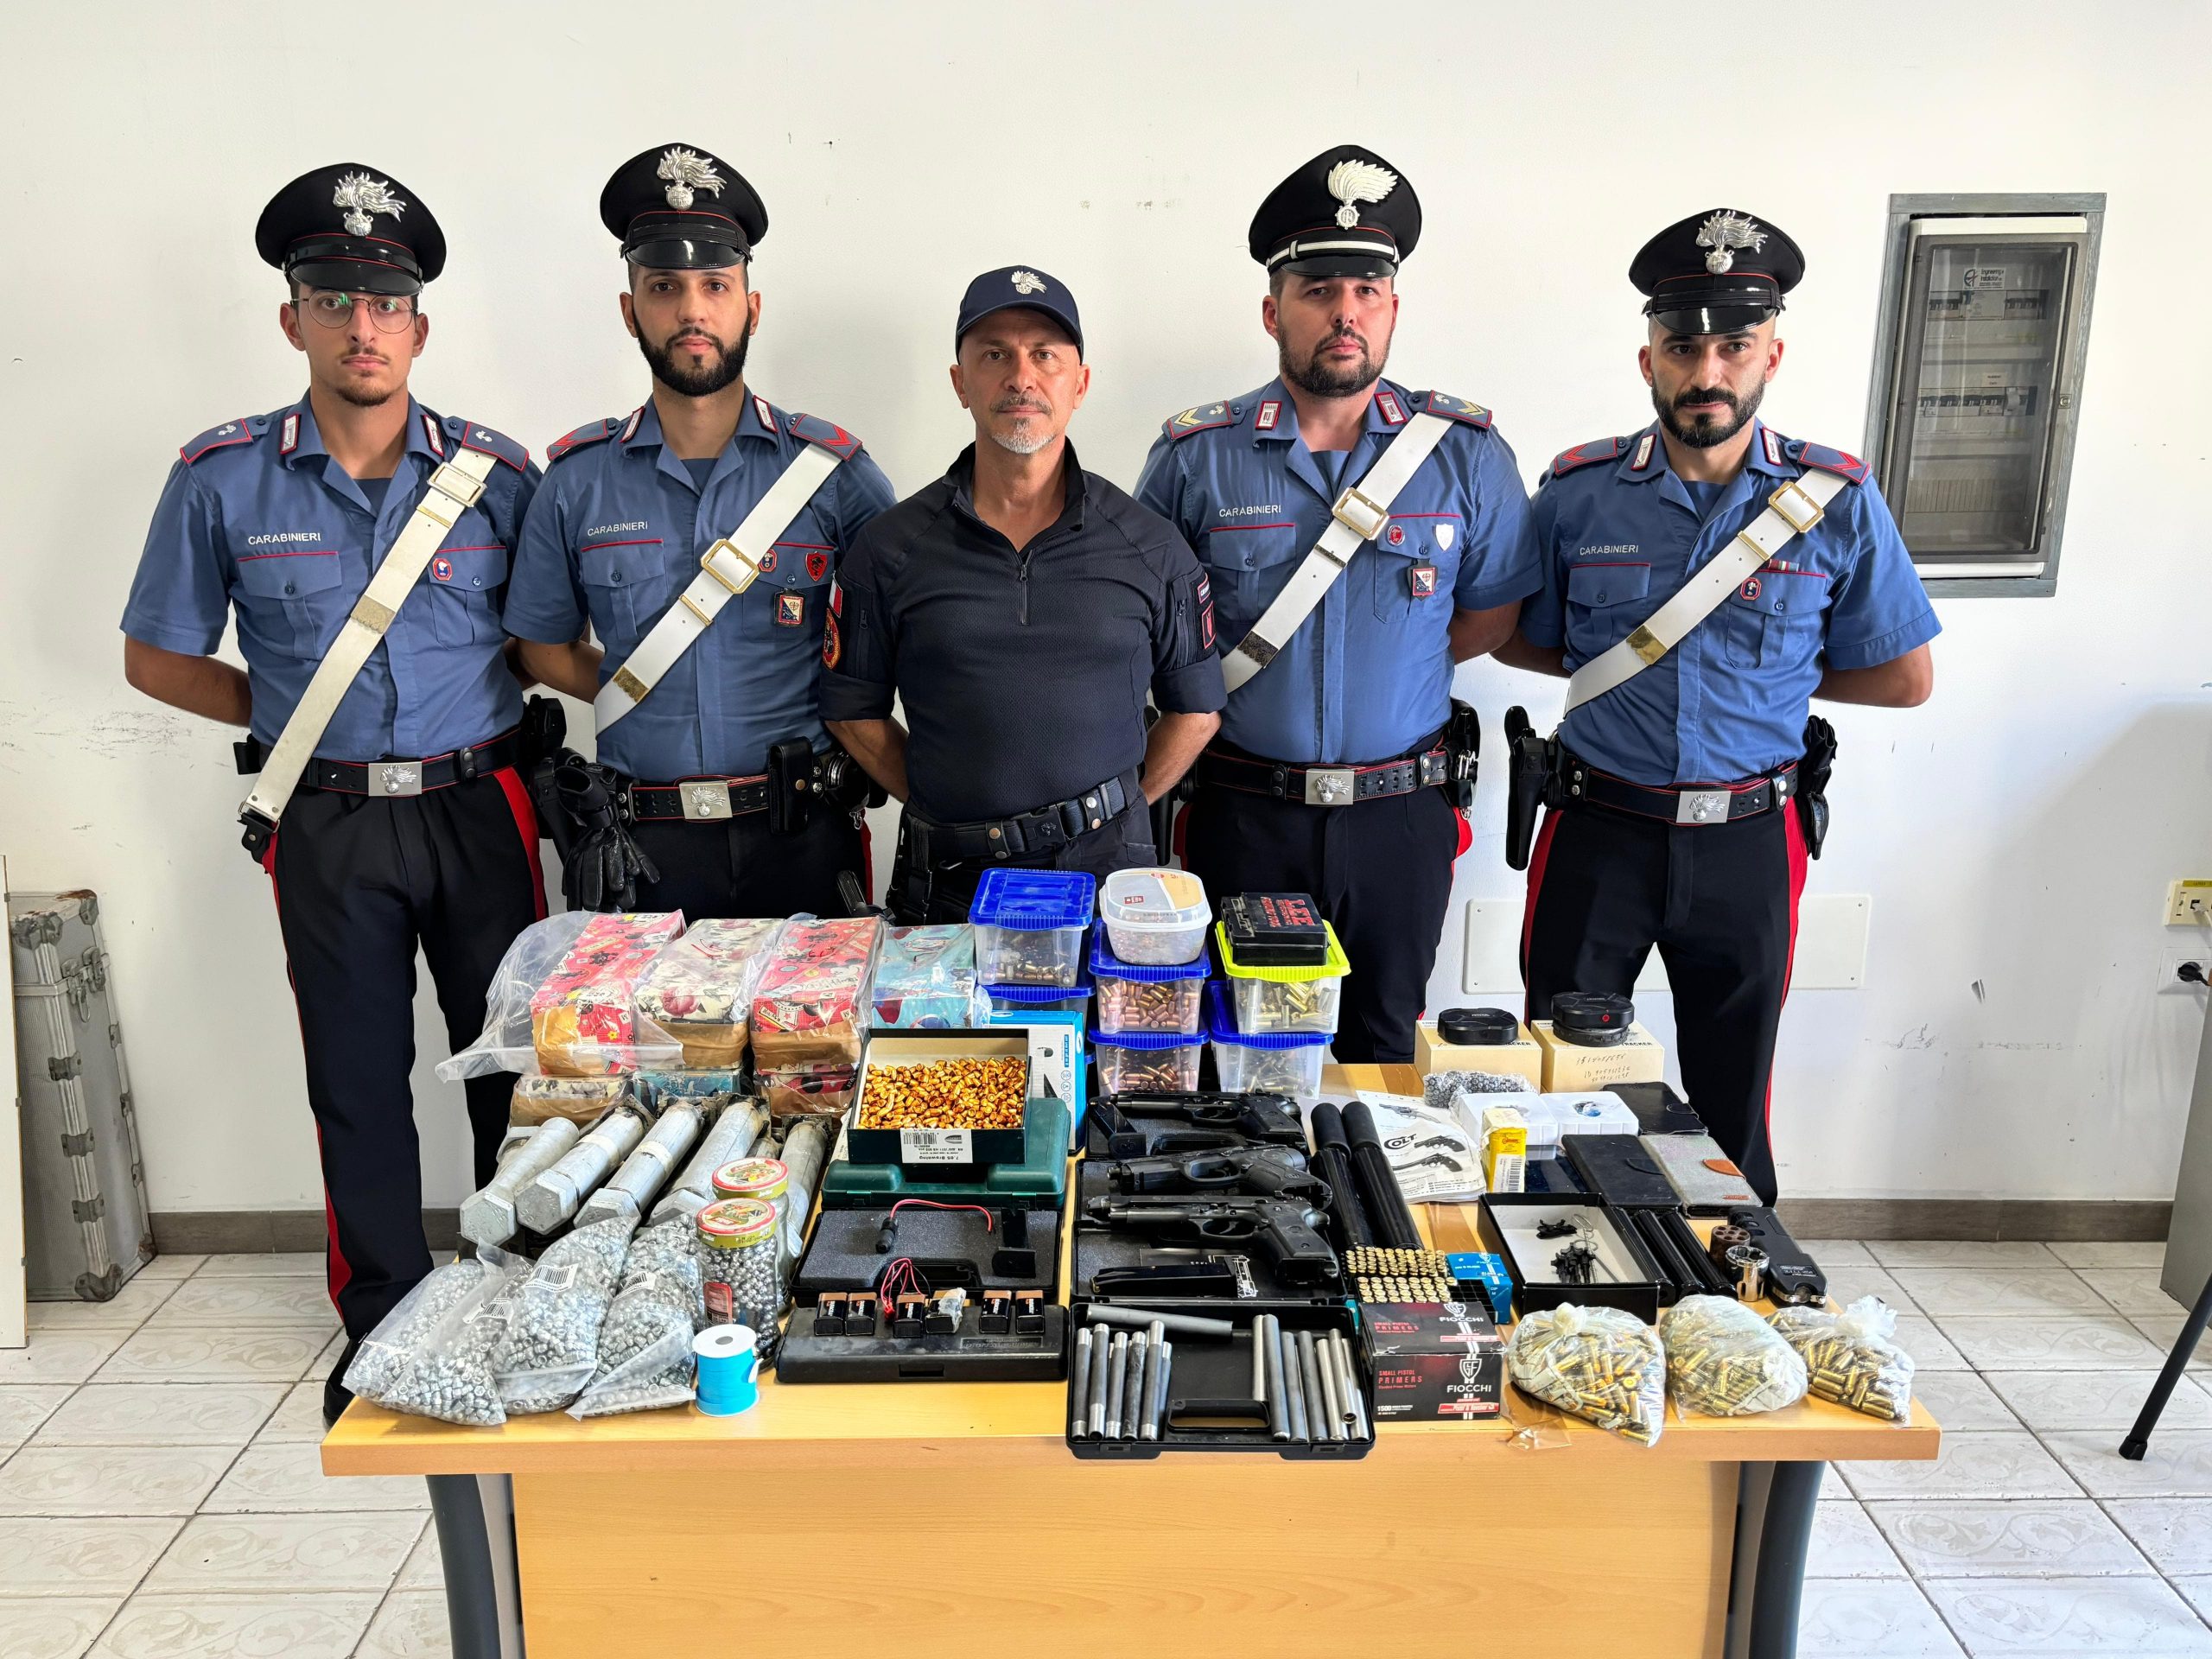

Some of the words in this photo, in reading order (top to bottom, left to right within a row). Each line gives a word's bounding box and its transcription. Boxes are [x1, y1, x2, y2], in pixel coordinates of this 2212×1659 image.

[1219, 505, 1281, 518] CARABINIERI
[588, 521, 648, 537] CARABINIERI
[248, 532, 321, 545] CARABINIERI
[1580, 544, 1639, 556] CARABINIERI
[1284, 899, 1315, 926] LEE
[1383, 1133, 1417, 1150] COLT
[1446, 1384, 1492, 1393] FIOCCHI
